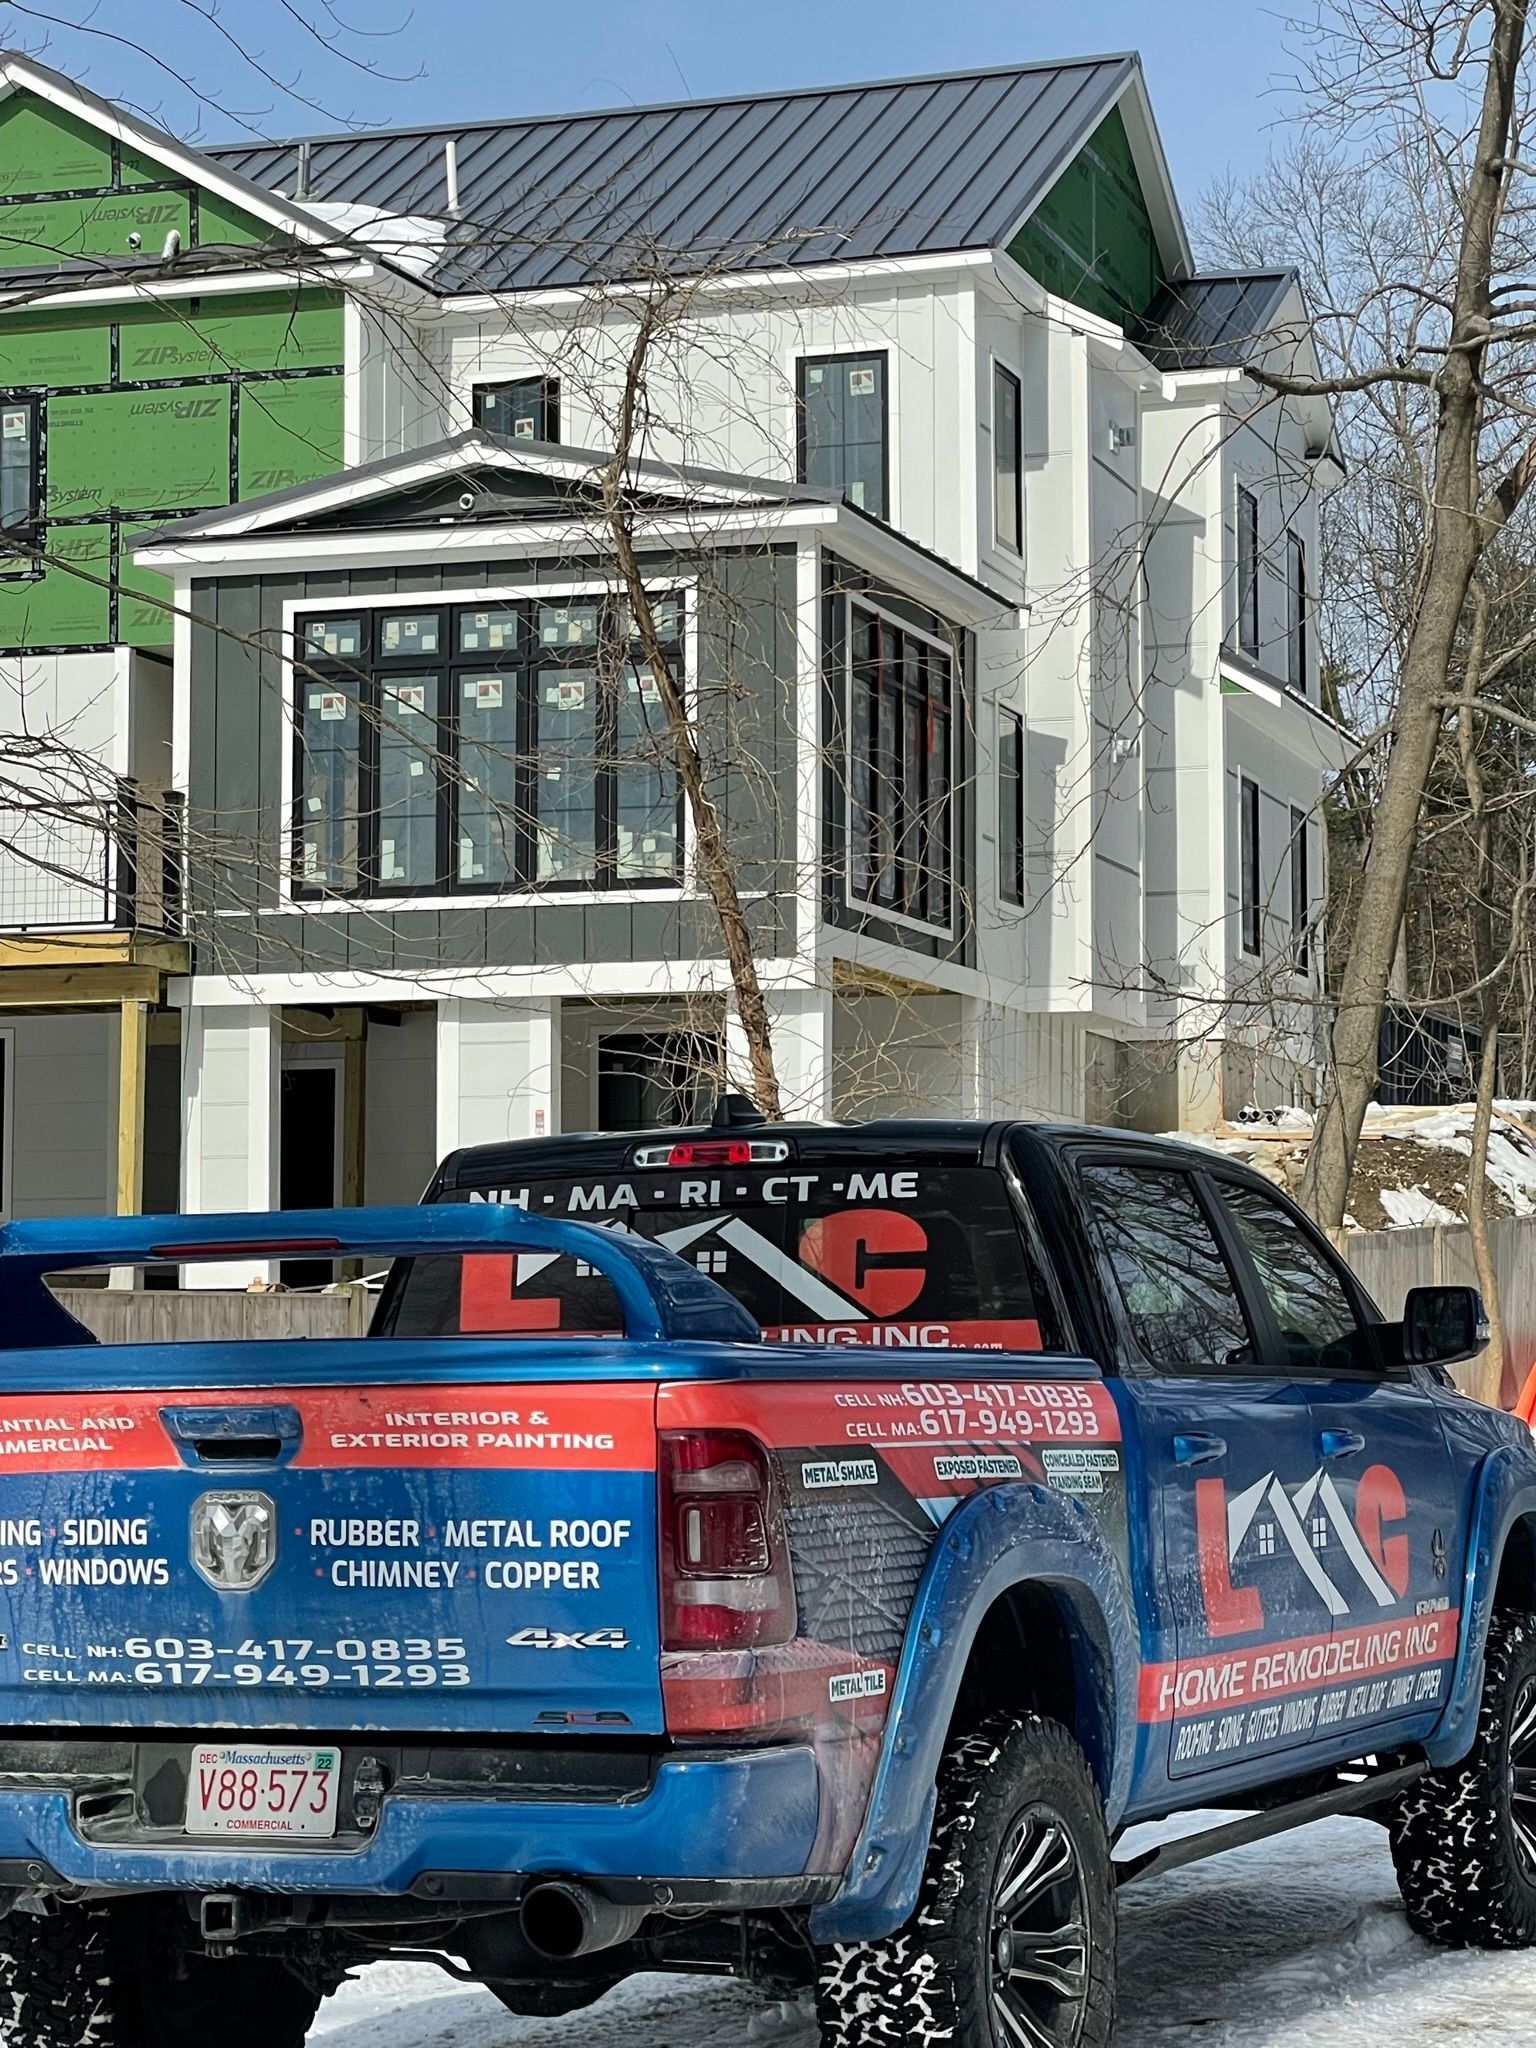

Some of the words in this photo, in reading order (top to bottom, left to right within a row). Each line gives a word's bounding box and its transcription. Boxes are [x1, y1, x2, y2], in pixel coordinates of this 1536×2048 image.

[469, 1189, 529, 1211] NH
[567, 1183, 640, 1211] MA
[680, 1180, 720, 1207] RI
[762, 1175, 819, 1204] CT
[846, 1171, 919, 1200] ME
[834, 1394, 875, 1408] CELL
[82, 1417, 135, 1430] AND
[385, 1412, 520, 1426] INTERIOR
[528, 1411, 550, 1425] &
[846, 1423, 887, 1437] CELL
[330, 1434, 469, 1448] EXTERIOR
[477, 1433, 614, 1449] PAINTING
[805, 1467, 840, 1484] METAL
[840, 1465, 876, 1481] SHAKE
[936, 1460, 977, 1475] EXPOSED
[977, 1458, 1020, 1475] FASTENER
[63, 1518, 148, 1545] SIDING
[310, 1519, 420, 1547] RUBBER
[445, 1520, 542, 1548] METAL
[551, 1519, 631, 1548] ROOF
[39, 1558, 169, 1585] WINDOWS
[331, 1560, 460, 1588] CHIMNEY
[485, 1561, 600, 1589] COPPER
[22, 1643, 77, 1659] CELL
[23, 1669, 80, 1682] CELL
[1159, 1660, 1248, 1711] HOME
[1252, 1630, 1401, 1692] REMODELING
[1405, 1621, 1439, 1659] INC
[832, 1677, 862, 1697] METAL
[864, 1674, 883, 1691] TILE
[1175, 1720, 1215, 1761] ROOFING
[1215, 1713, 1246, 1751] SIDING
[1281, 1696, 1318, 1736] WINDOWS
[199, 1753, 218, 1764] DEC
[224, 1750, 306, 1765] Massachusetts
[317, 1759, 332, 1769] 22
[226, 1819, 293, 1830] COMMERCIAL
